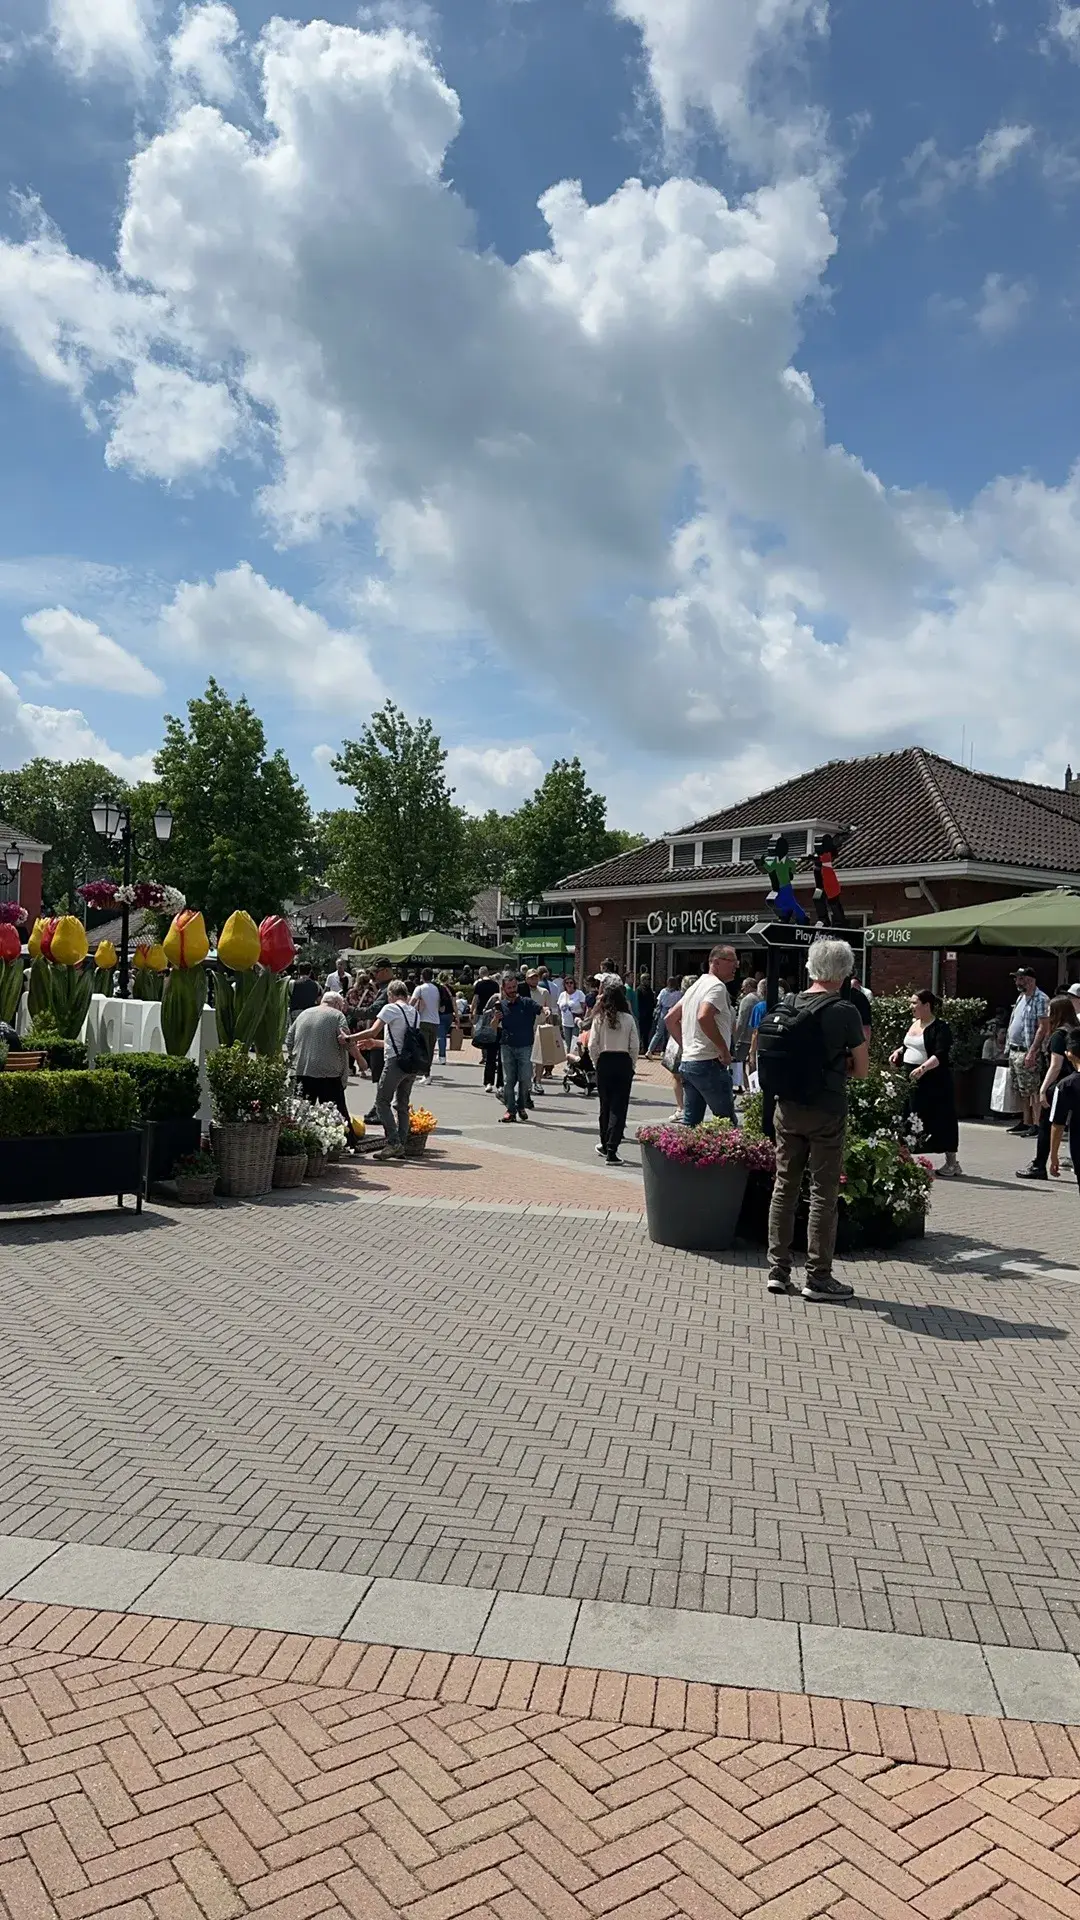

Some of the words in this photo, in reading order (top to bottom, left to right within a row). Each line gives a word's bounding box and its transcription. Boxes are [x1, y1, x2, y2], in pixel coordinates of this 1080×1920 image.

[667, 912, 677, 933] La
[681, 910, 718, 933] PLACE
[795, 929, 812, 944] Play
[877, 930, 885, 941] La
[887, 929, 911, 942] PLACE
